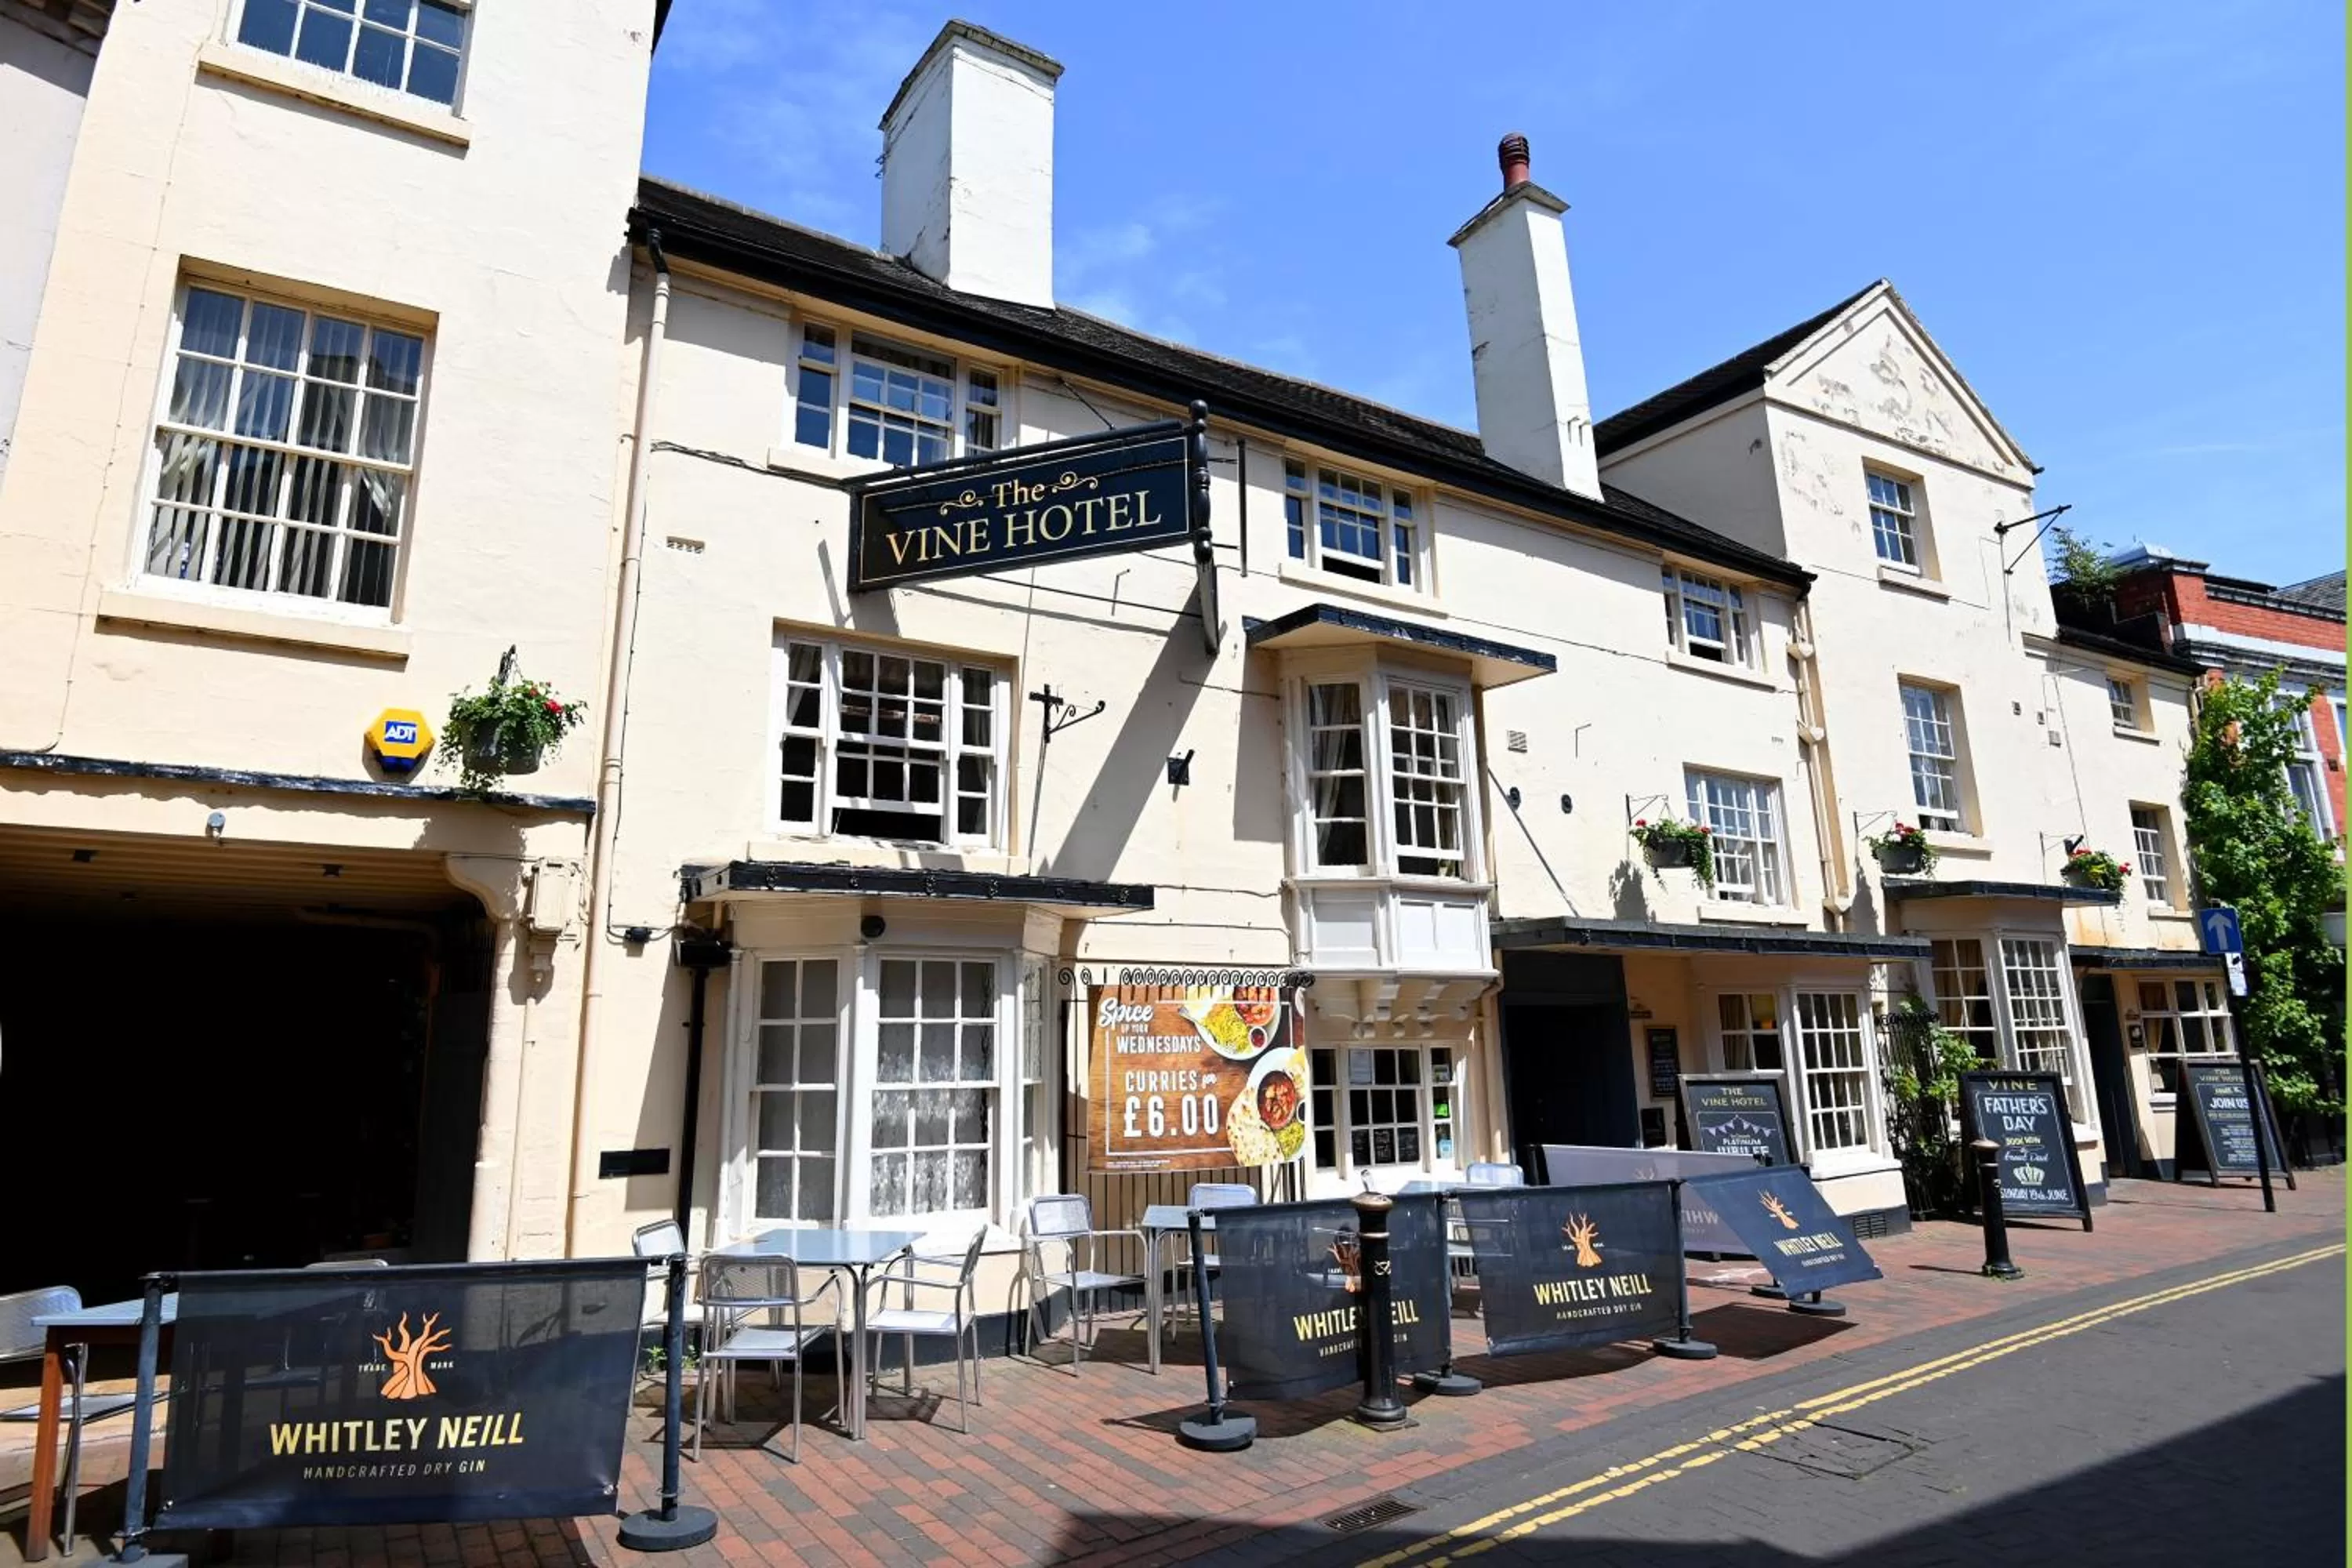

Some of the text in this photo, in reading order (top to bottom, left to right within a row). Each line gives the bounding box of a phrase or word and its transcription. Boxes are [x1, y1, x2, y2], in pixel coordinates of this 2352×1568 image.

[990, 478, 1045, 509] The
[886, 490, 1161, 565] VINE HOTEL
[385, 724, 416, 741] ADT
[1099, 996, 1153, 1030] Spice
[1116, 1035, 1200, 1054] WEDNESDAYS
[1126, 1069, 1197, 1092] CURRIES
[1987, 1079, 2038, 1091] VINE
[1700, 1098, 1768, 1106] VINE HOTEL
[1123, 1093, 1219, 1137] £6.00
[2002, 1116, 2035, 1131] DAY
[1534, 1273, 1652, 1305] WHITLEY NEILL
[1294, 1299, 1420, 1341] WHITLE EILL
[1556, 1306, 1611, 1319] HANDCRAFTED
[270, 1412, 524, 1456] WHITLEY NEILL
[304, 1459, 485, 1479] HANDCRAFTED DRY GIN
